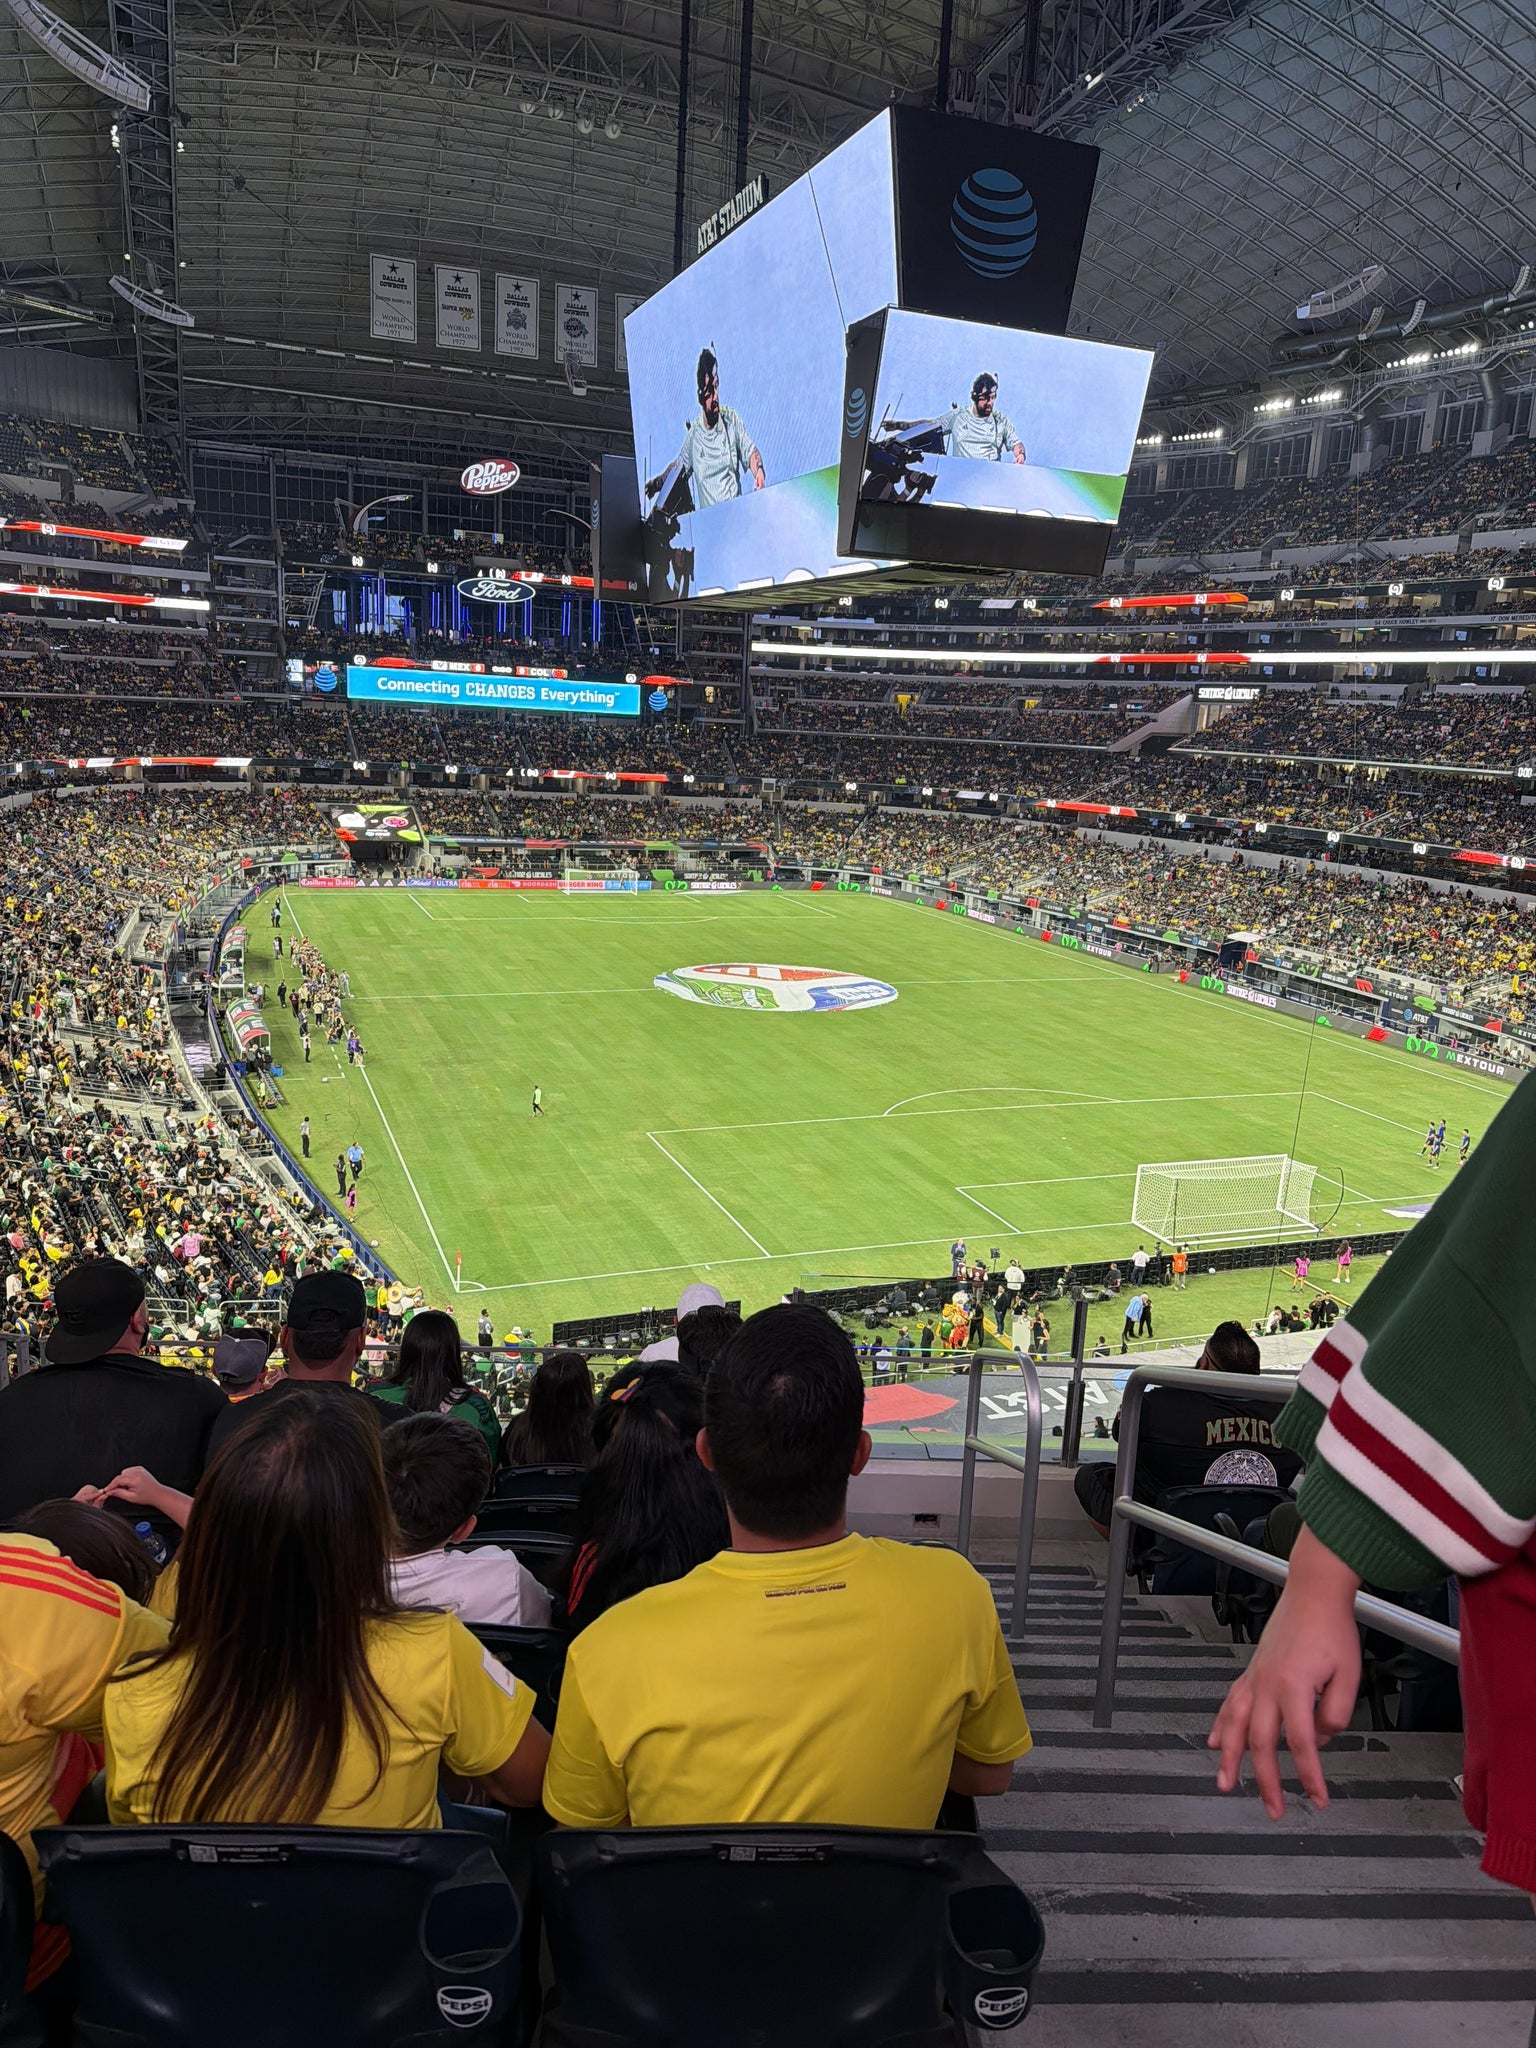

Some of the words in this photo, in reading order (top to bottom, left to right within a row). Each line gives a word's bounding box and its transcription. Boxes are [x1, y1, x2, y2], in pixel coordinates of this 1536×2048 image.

[697, 213, 718, 254] AT&T
[719, 174, 764, 235] STADIUM
[382, 274, 405, 284] DALLAS
[379, 281, 408, 290] COWBOYS
[447, 285, 469, 293] DALLAS
[444, 291, 472, 300] COWBOYS
[506, 293, 528, 301] DALLAS
[441, 303, 458, 312] SUPER
[458, 306, 476, 314] BOWL
[504, 300, 531, 309] COWBOYS
[566, 303, 587, 311] DALLAS
[382, 313, 406, 323] WORLD
[563, 308, 590, 318] COWBOYS
[374, 320, 413, 332] CHAMPIONS
[447, 323, 470, 332] WORLD
[440, 330, 478, 340] CHAMPIONS
[505, 331, 529, 340] WORLD
[499, 338, 535, 348] CHAMPIONS
[565, 340, 588, 349] WORLD
[510, 346, 524, 354] 1992
[483, 461, 506, 476] Dr
[466, 463, 516, 490] Pepper
[472, 580, 522, 600] Ford
[448, 662, 470, 672] MEX
[530, 667, 549, 677] COL
[377, 677, 460, 698] Connecting
[466, 682, 536, 700] CHANGES
[540, 688, 616, 707] Everything
[1081, 943, 1112, 958] MEXTOUR
[1379, 988, 1409, 1001] MEXTOUR
[1412, 1013, 1430, 1024] AT&T
[1446, 1050, 1505, 1076] MEXTOUR
[440, 1997, 489, 2012] PEPSI
[979, 1995, 1025, 2012] PEPSI
